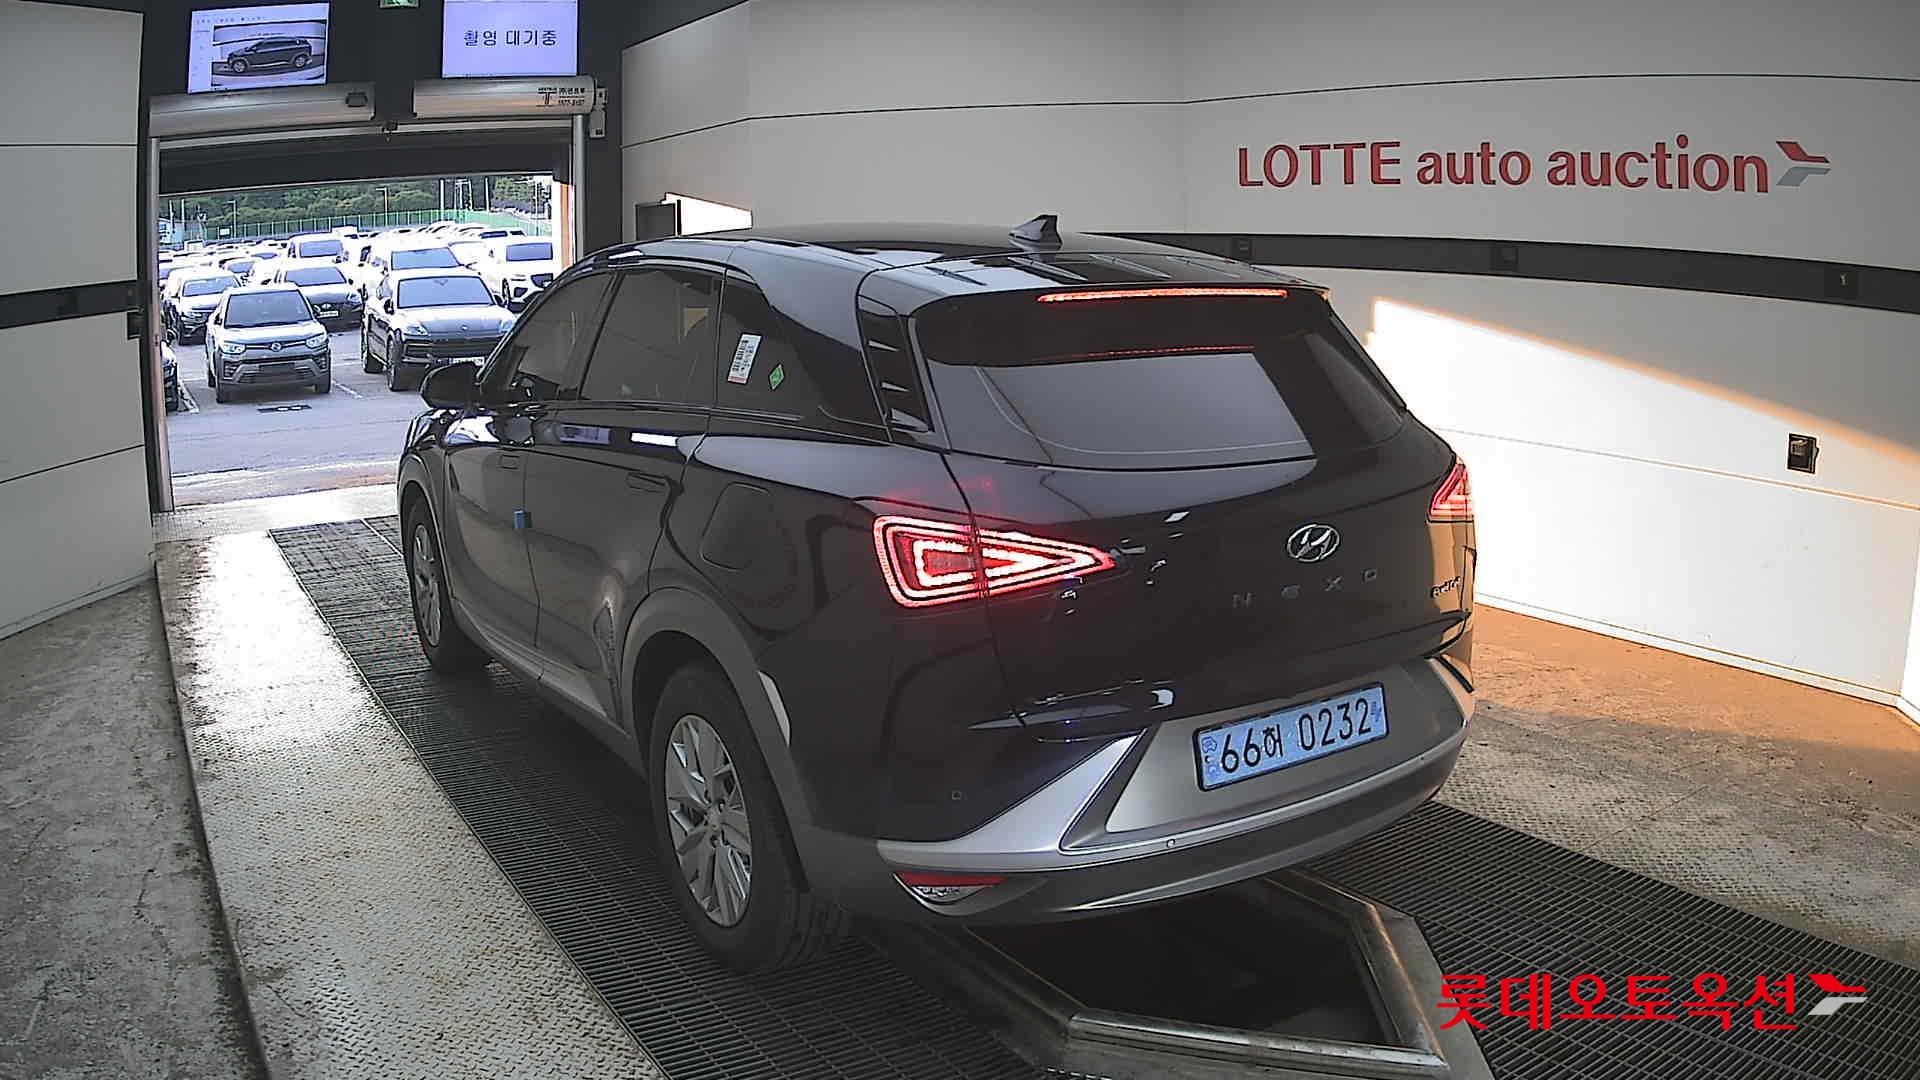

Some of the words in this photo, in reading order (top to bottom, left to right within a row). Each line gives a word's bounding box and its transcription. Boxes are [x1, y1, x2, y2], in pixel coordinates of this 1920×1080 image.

[505, 29, 558, 47] 대기중
[1238, 140, 1401, 188] LOTTE
[1416, 141, 1532, 186] auto
[1547, 133, 1769, 194] auction
[1221, 723, 1284, 774] 66허
[1298, 697, 1373, 752] 0232
